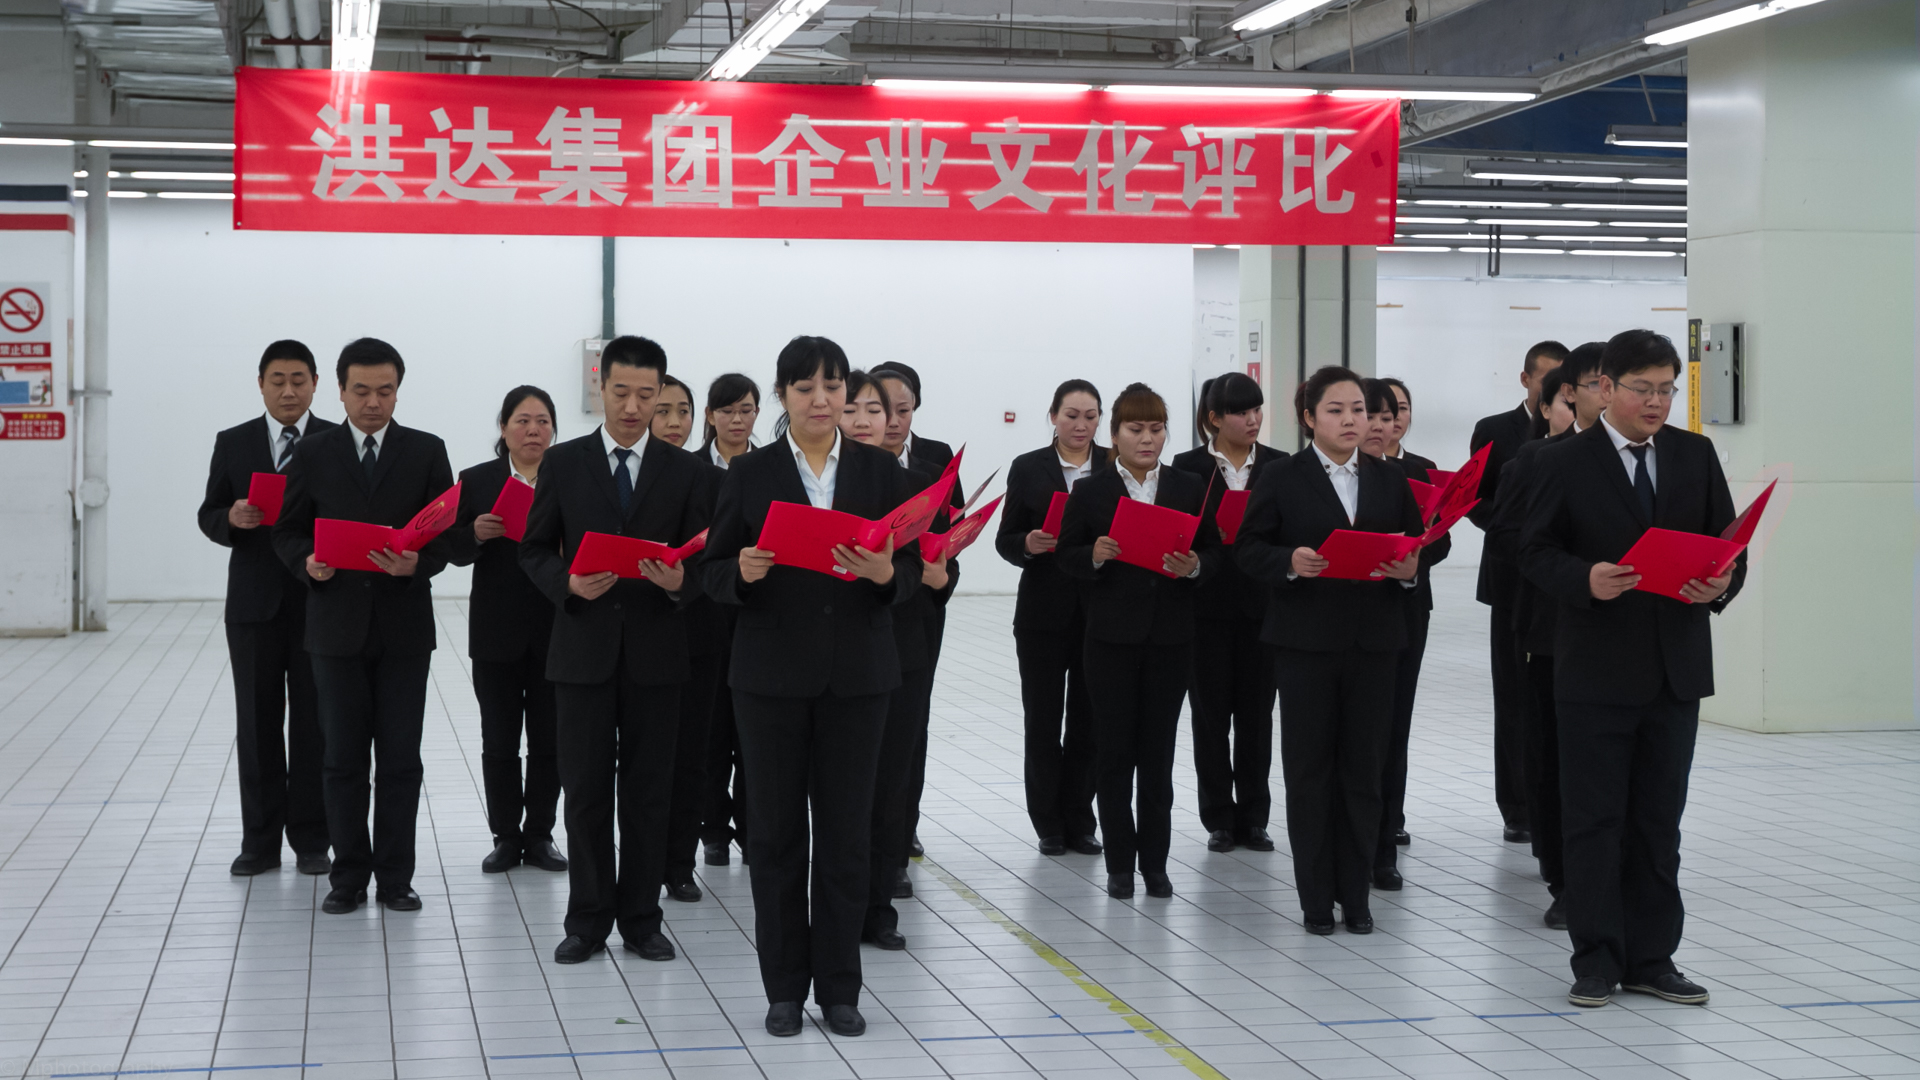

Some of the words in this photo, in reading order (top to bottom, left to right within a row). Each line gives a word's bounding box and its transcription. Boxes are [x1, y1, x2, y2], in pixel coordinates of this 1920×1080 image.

[310, 103, 1355, 217] 洪达集团企业文化评比
